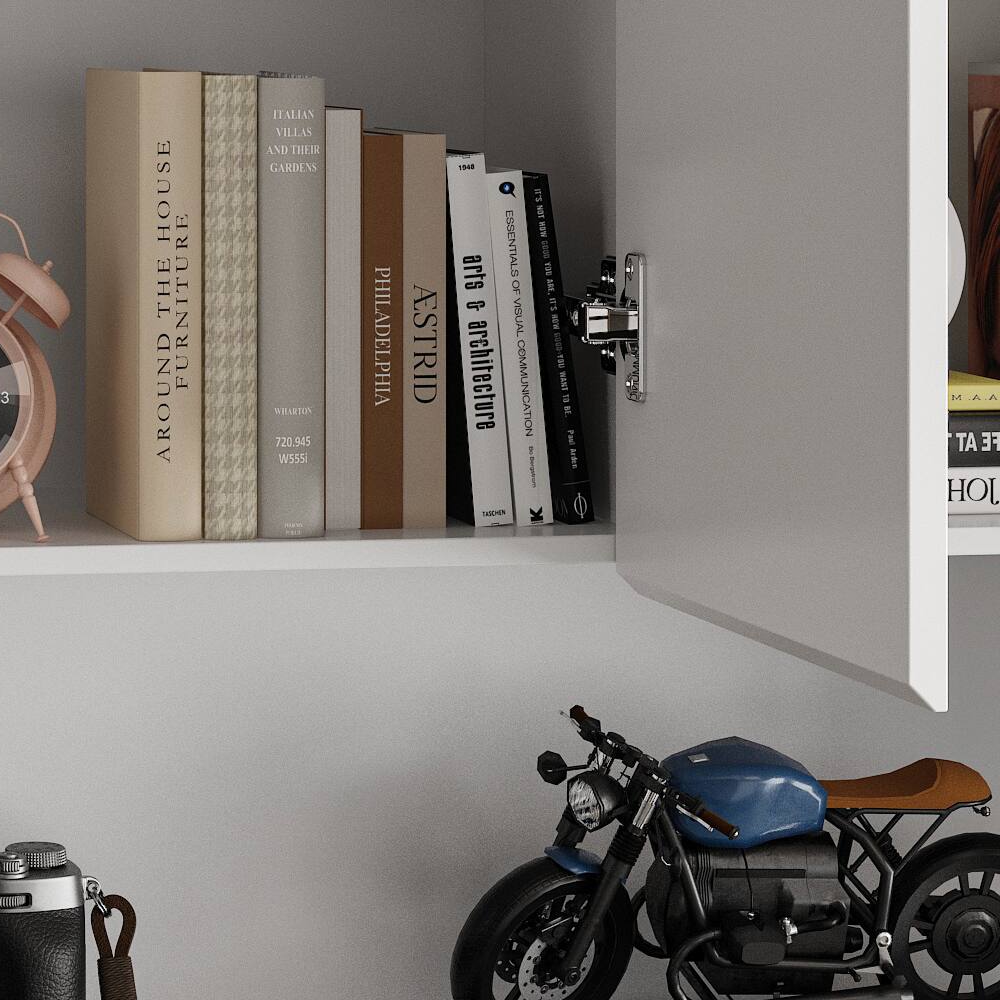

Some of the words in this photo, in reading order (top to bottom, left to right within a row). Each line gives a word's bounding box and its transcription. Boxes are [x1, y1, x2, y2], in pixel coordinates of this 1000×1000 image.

[272, 108, 315, 121] ITALIAN
[275, 126, 313, 139] VILLAS
[266, 144, 289, 156] AND
[290, 143, 321, 156] THEIR
[269, 161, 318, 174] GARDENS
[156, 140, 171, 243] HOUSE
[505, 209, 519, 278] ESSENTIALS
[157, 257, 171, 319] THE
[462, 254, 486, 291] arts
[511, 280, 521, 295] OF
[175, 213, 190, 391] FURNITURE
[513, 297, 524, 337] VISUAL
[375, 266, 391, 407] PHILADELPHIA
[412, 283, 438, 405] ÆSTRID
[467, 318, 496, 431] architecture
[517, 339, 533, 437] COMMUNICATION
[0, 391, 10, 405] 3
[156, 332, 171, 463] AROUND
[273, 405, 313, 417] WHARTON
[275, 434, 312, 449] 720.945
[482, 509, 506, 518] TASCHEN
